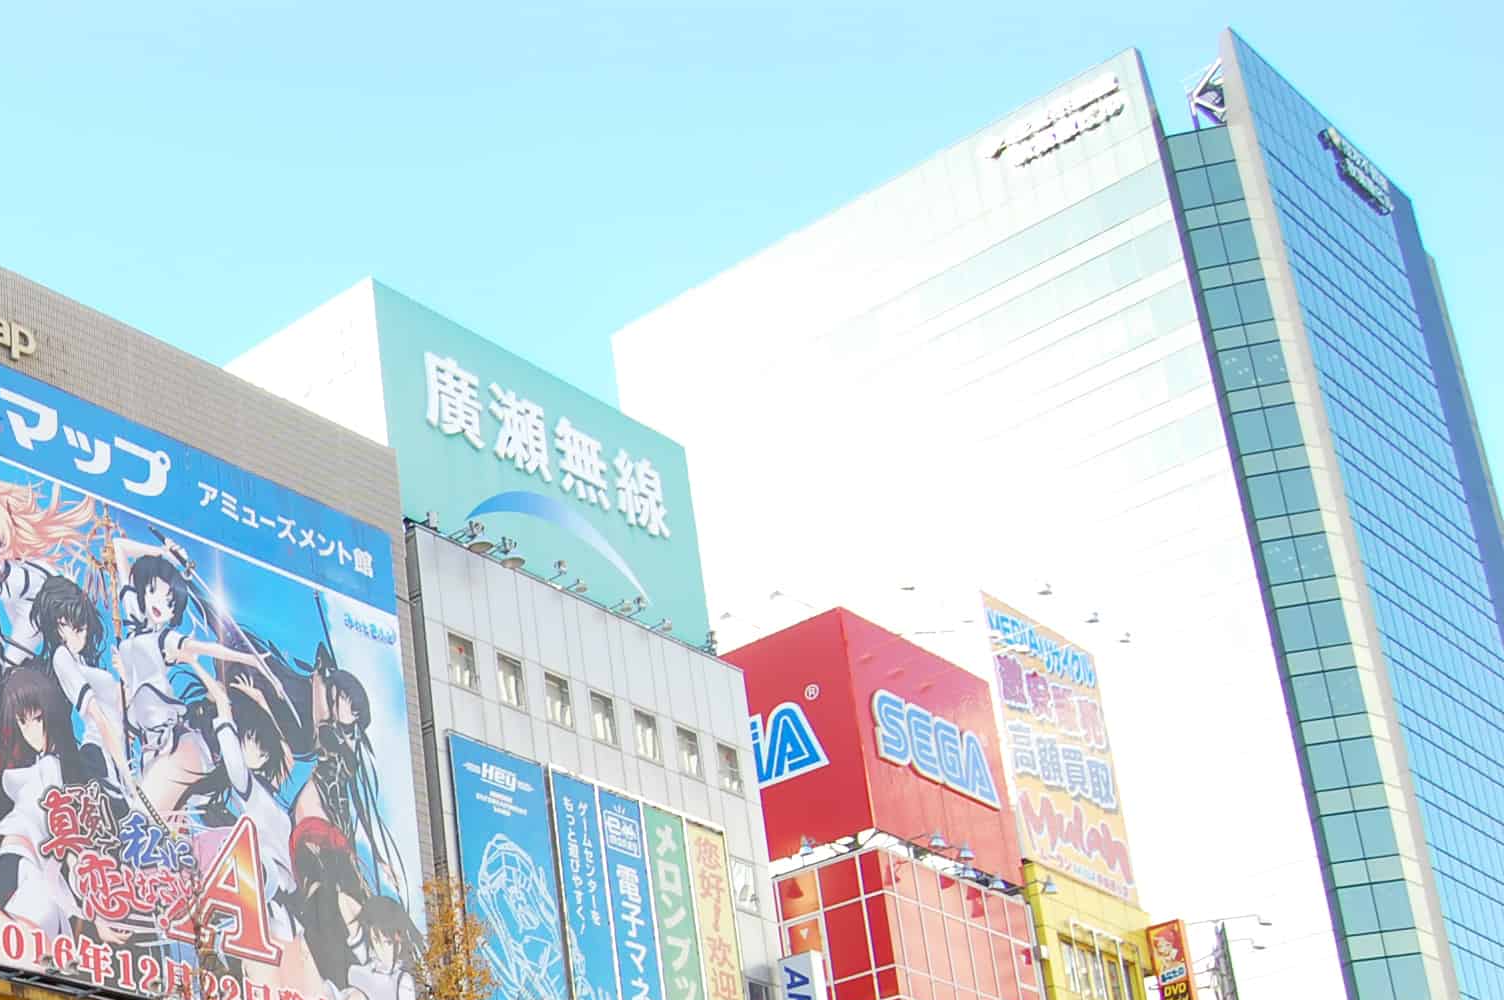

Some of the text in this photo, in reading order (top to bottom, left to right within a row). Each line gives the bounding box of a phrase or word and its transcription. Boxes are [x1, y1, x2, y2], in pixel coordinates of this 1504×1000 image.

[196, 480, 375, 579] アミューズメント館
[480, 762, 517, 792] Hey
[752, 702, 830, 788] A
[872, 688, 1000, 812] SEGA
[1163, 982, 1188, 999] DVD
